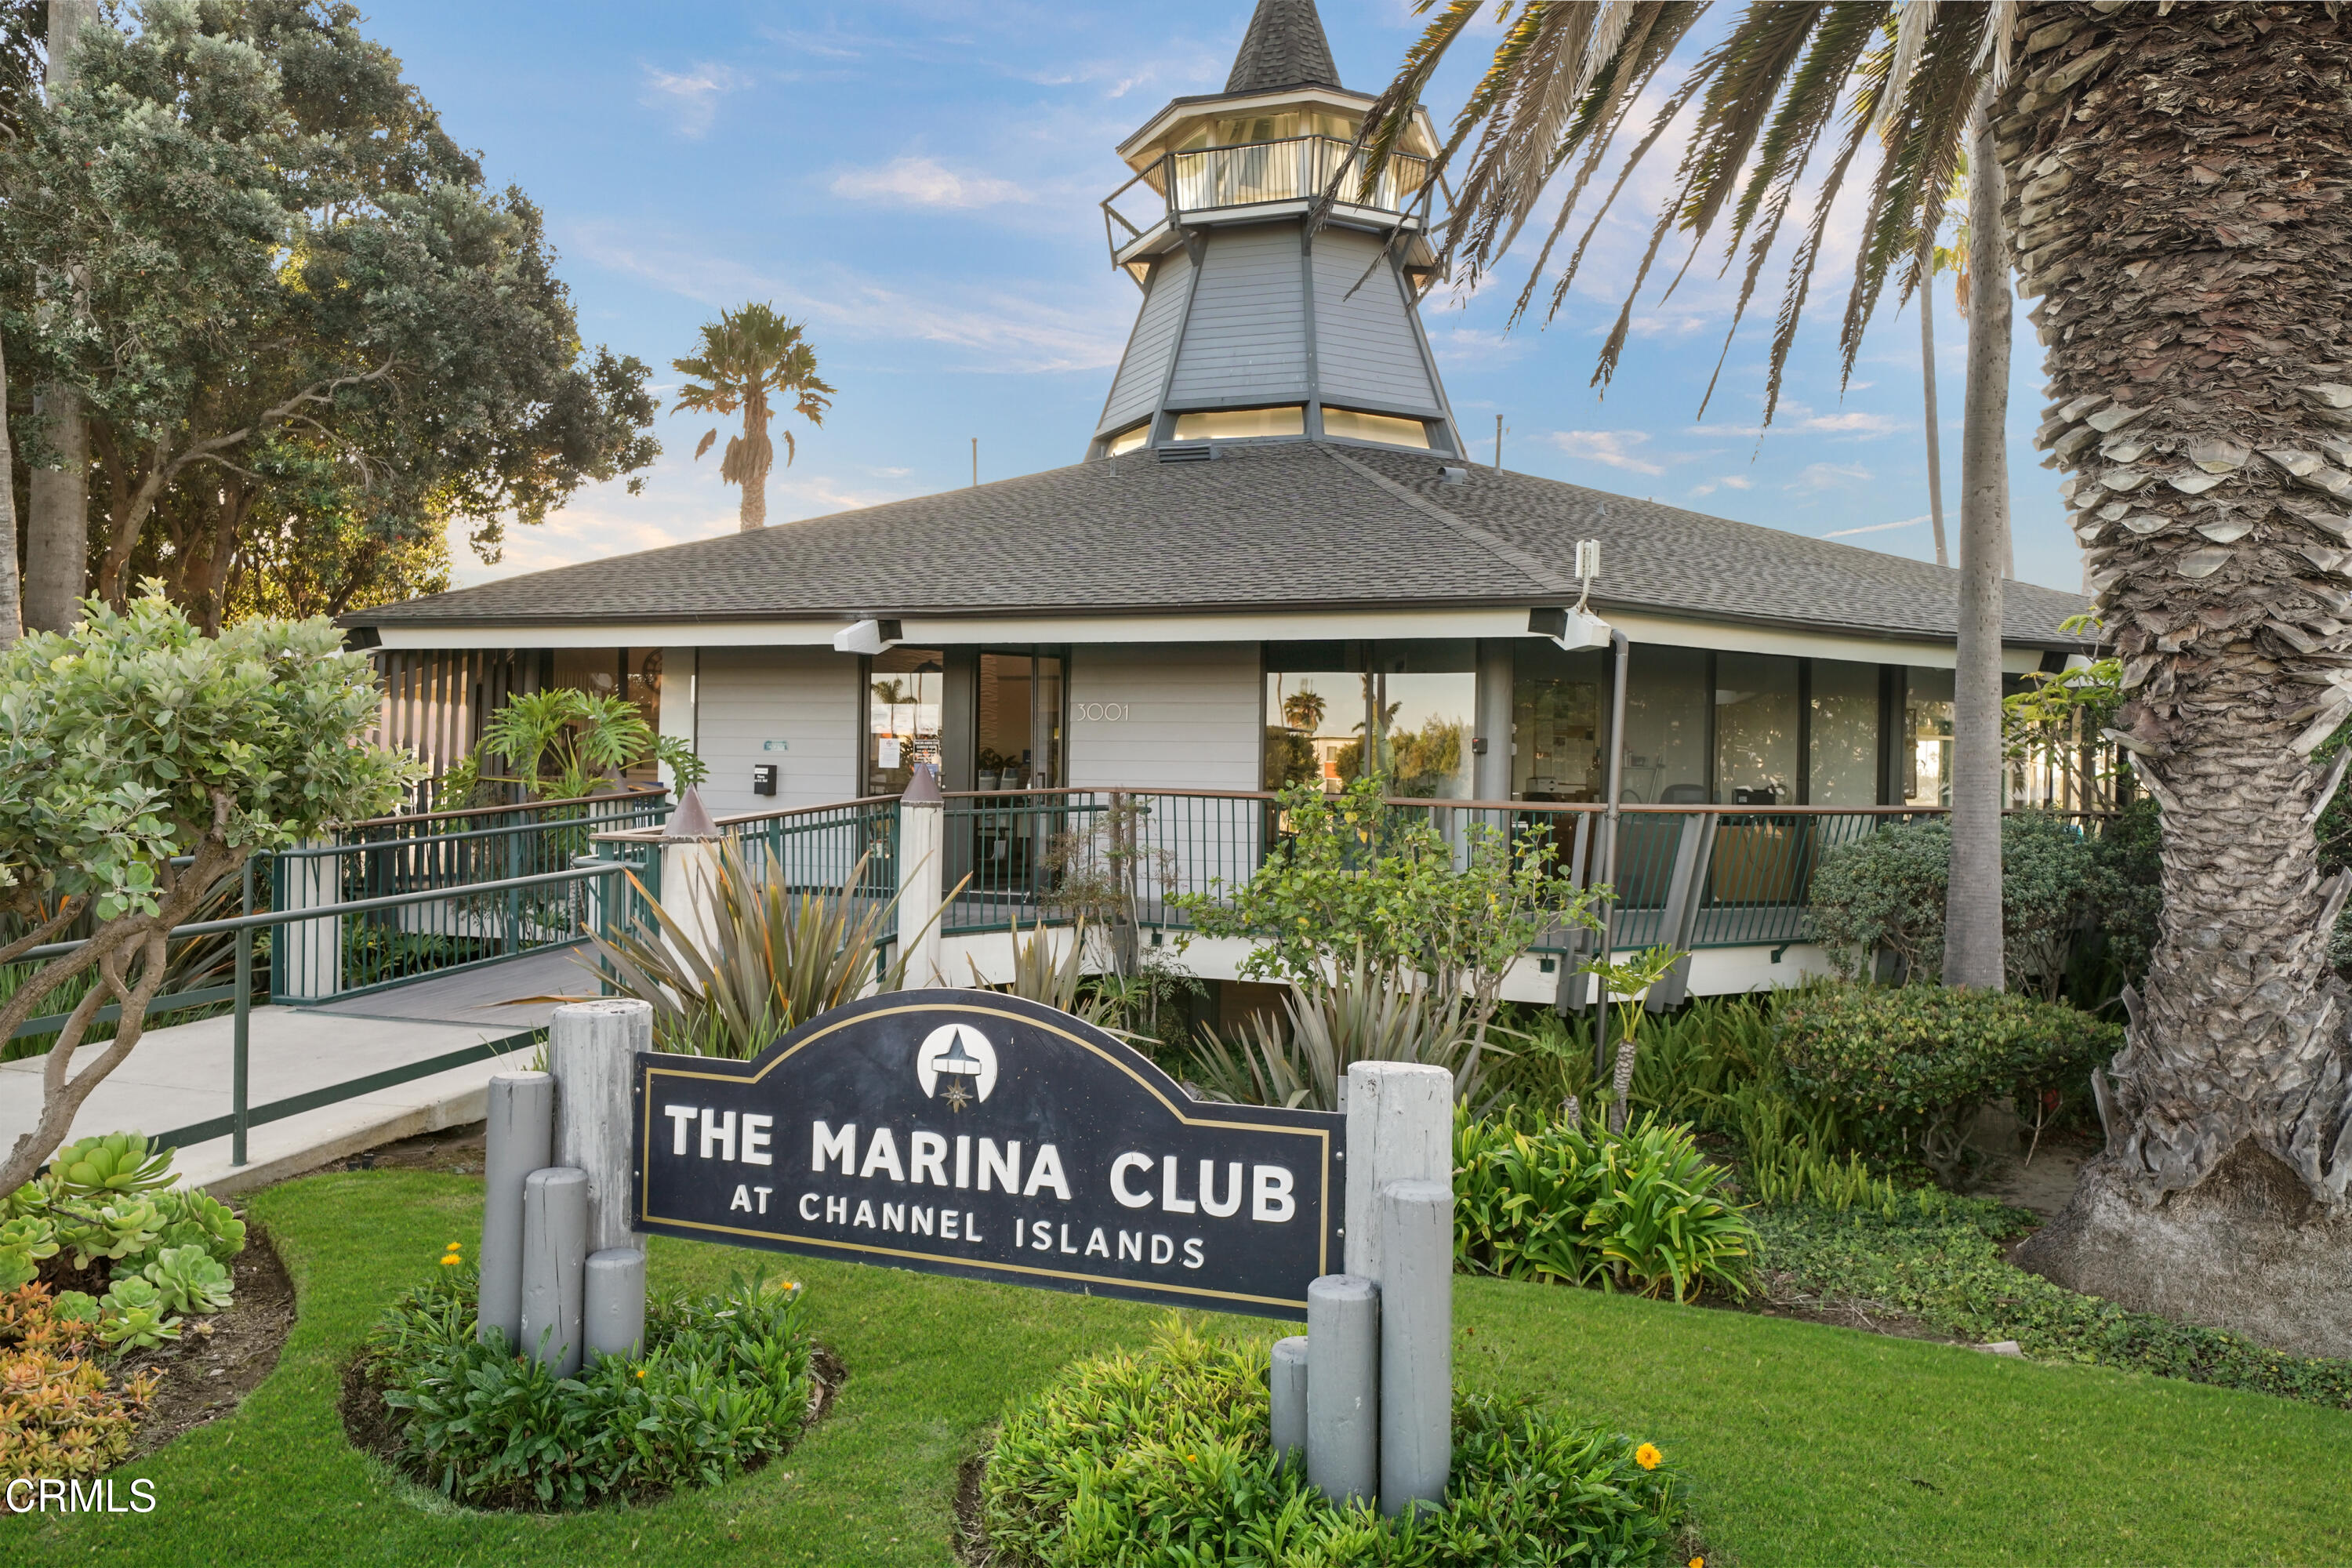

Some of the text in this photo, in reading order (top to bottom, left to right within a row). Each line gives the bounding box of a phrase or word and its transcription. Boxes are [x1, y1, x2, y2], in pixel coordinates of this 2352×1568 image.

[1077, 702, 1129, 721] 3001
[665, 1105, 1295, 1222] THE MARINA CLUB
[730, 1184, 1205, 1269] AT CHANNEL ISLANDS
